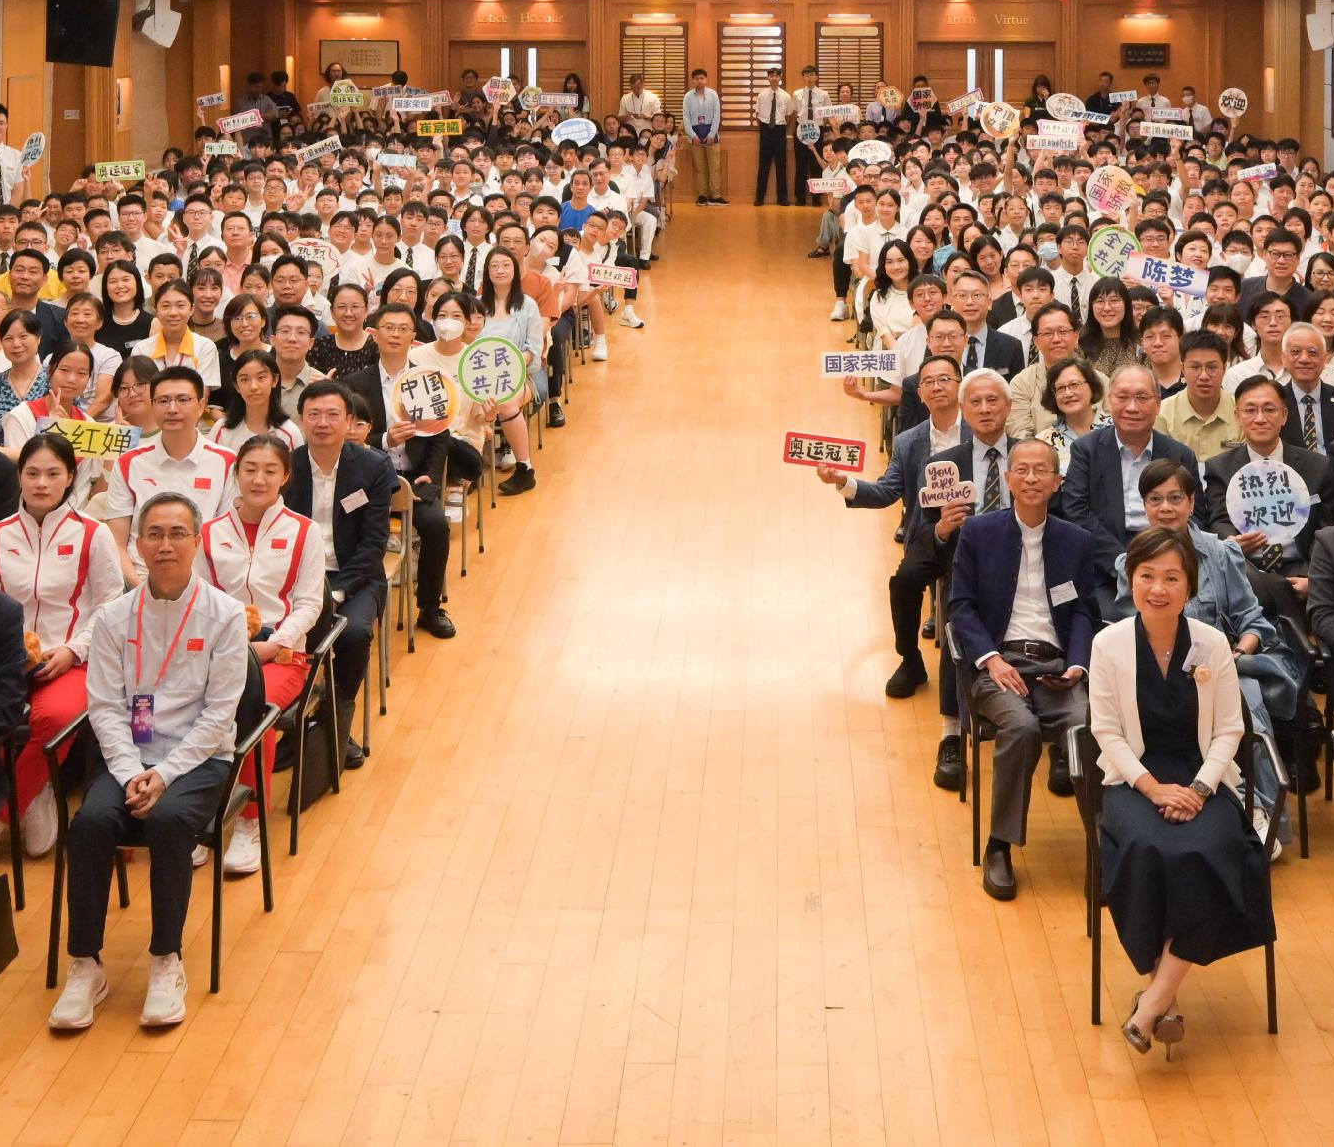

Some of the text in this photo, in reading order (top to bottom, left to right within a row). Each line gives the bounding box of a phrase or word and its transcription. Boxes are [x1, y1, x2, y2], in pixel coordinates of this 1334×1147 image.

[994, 13, 1029, 25] Virtue
[1221, 95, 1246, 111] 欢迎
[98, 163, 142, 179] 奥运冠军
[592, 268, 633, 284] 热烈欢迎
[1142, 257, 1195, 288] 陈梦
[469, 347, 511, 371] 全民
[825, 353, 897, 373] 国家荣耀
[400, 370, 445, 400] 中国
[471, 371, 516, 396] 共庆
[408, 394, 449, 422] 力量
[789, 437, 861, 466] 奥运冠军
[1238, 470, 1292, 499] 热烈
[1243, 500, 1296, 527] 欢迎
